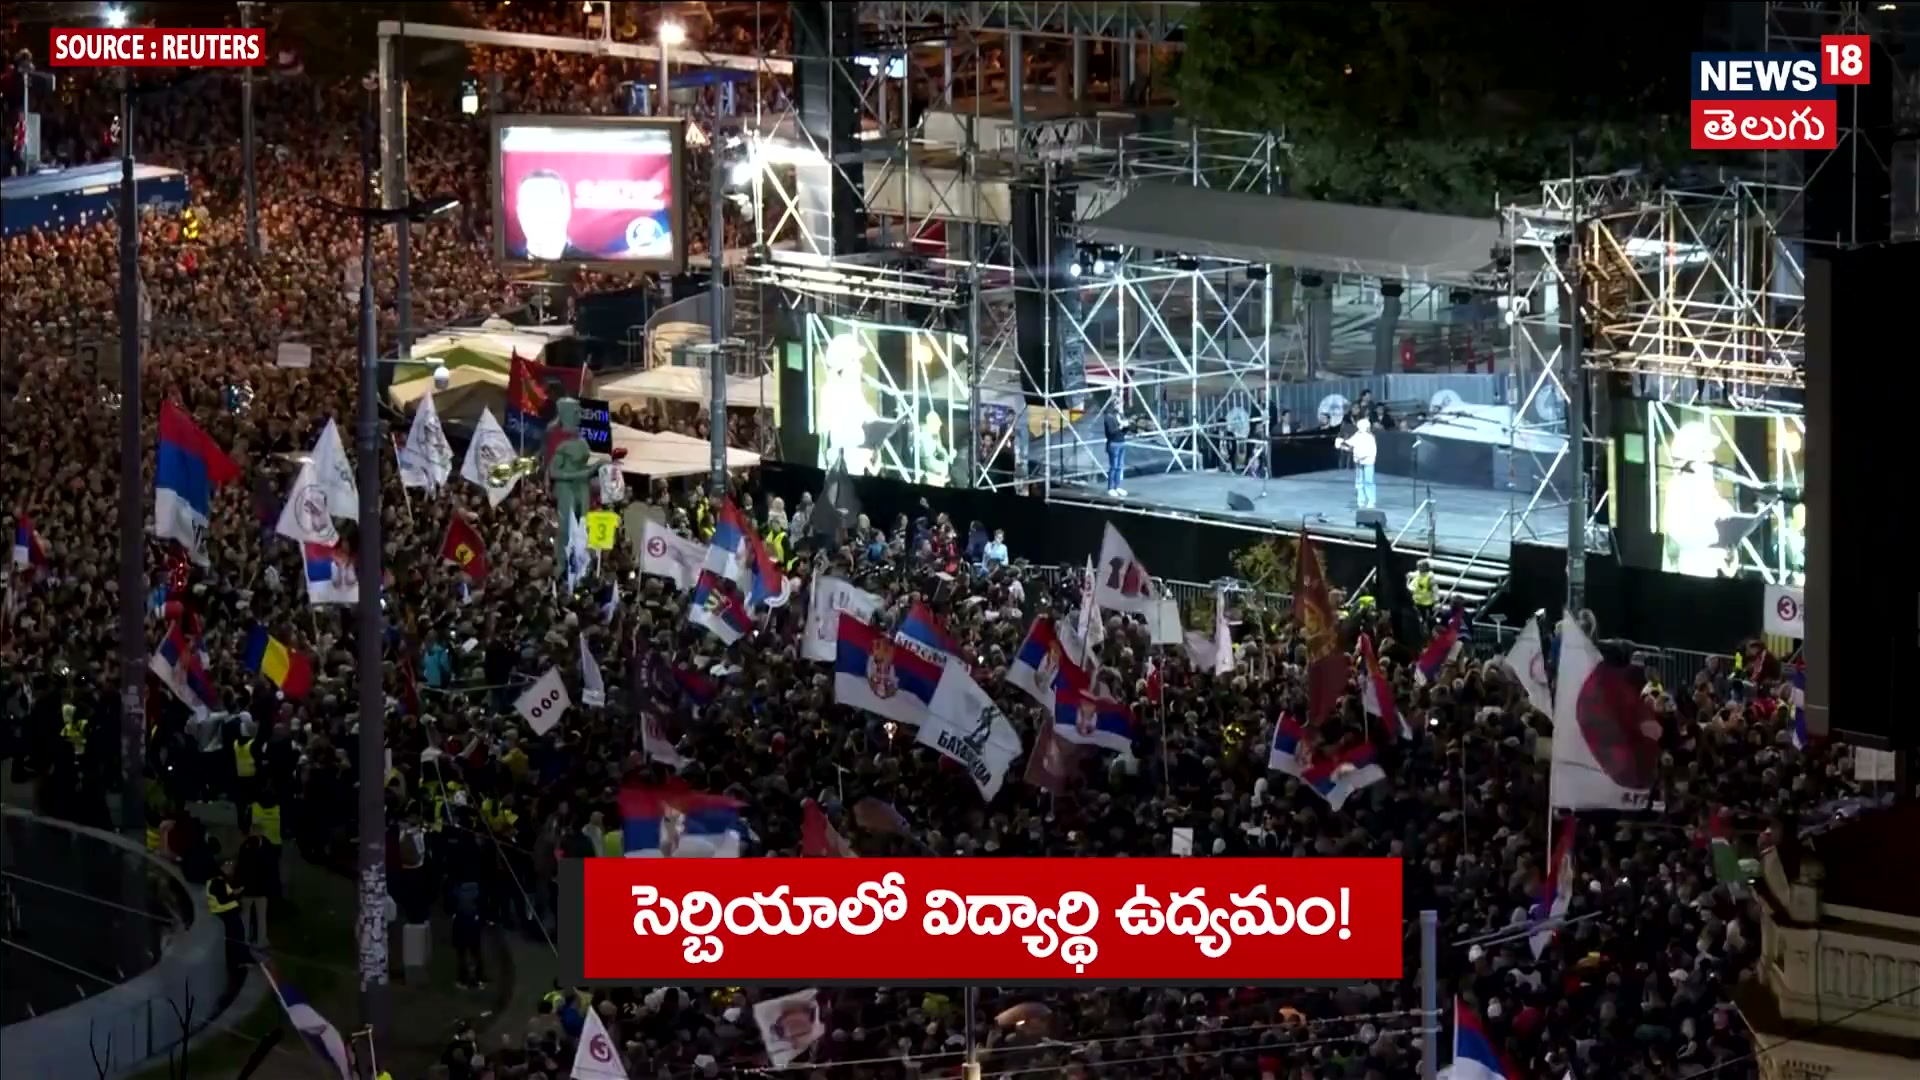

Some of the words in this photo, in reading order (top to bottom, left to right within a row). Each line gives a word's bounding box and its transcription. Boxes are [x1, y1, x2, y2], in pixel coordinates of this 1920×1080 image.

[597, 523, 607, 540] 3
[649, 538, 664, 556] 3
[1779, 597, 1794, 619] 3
